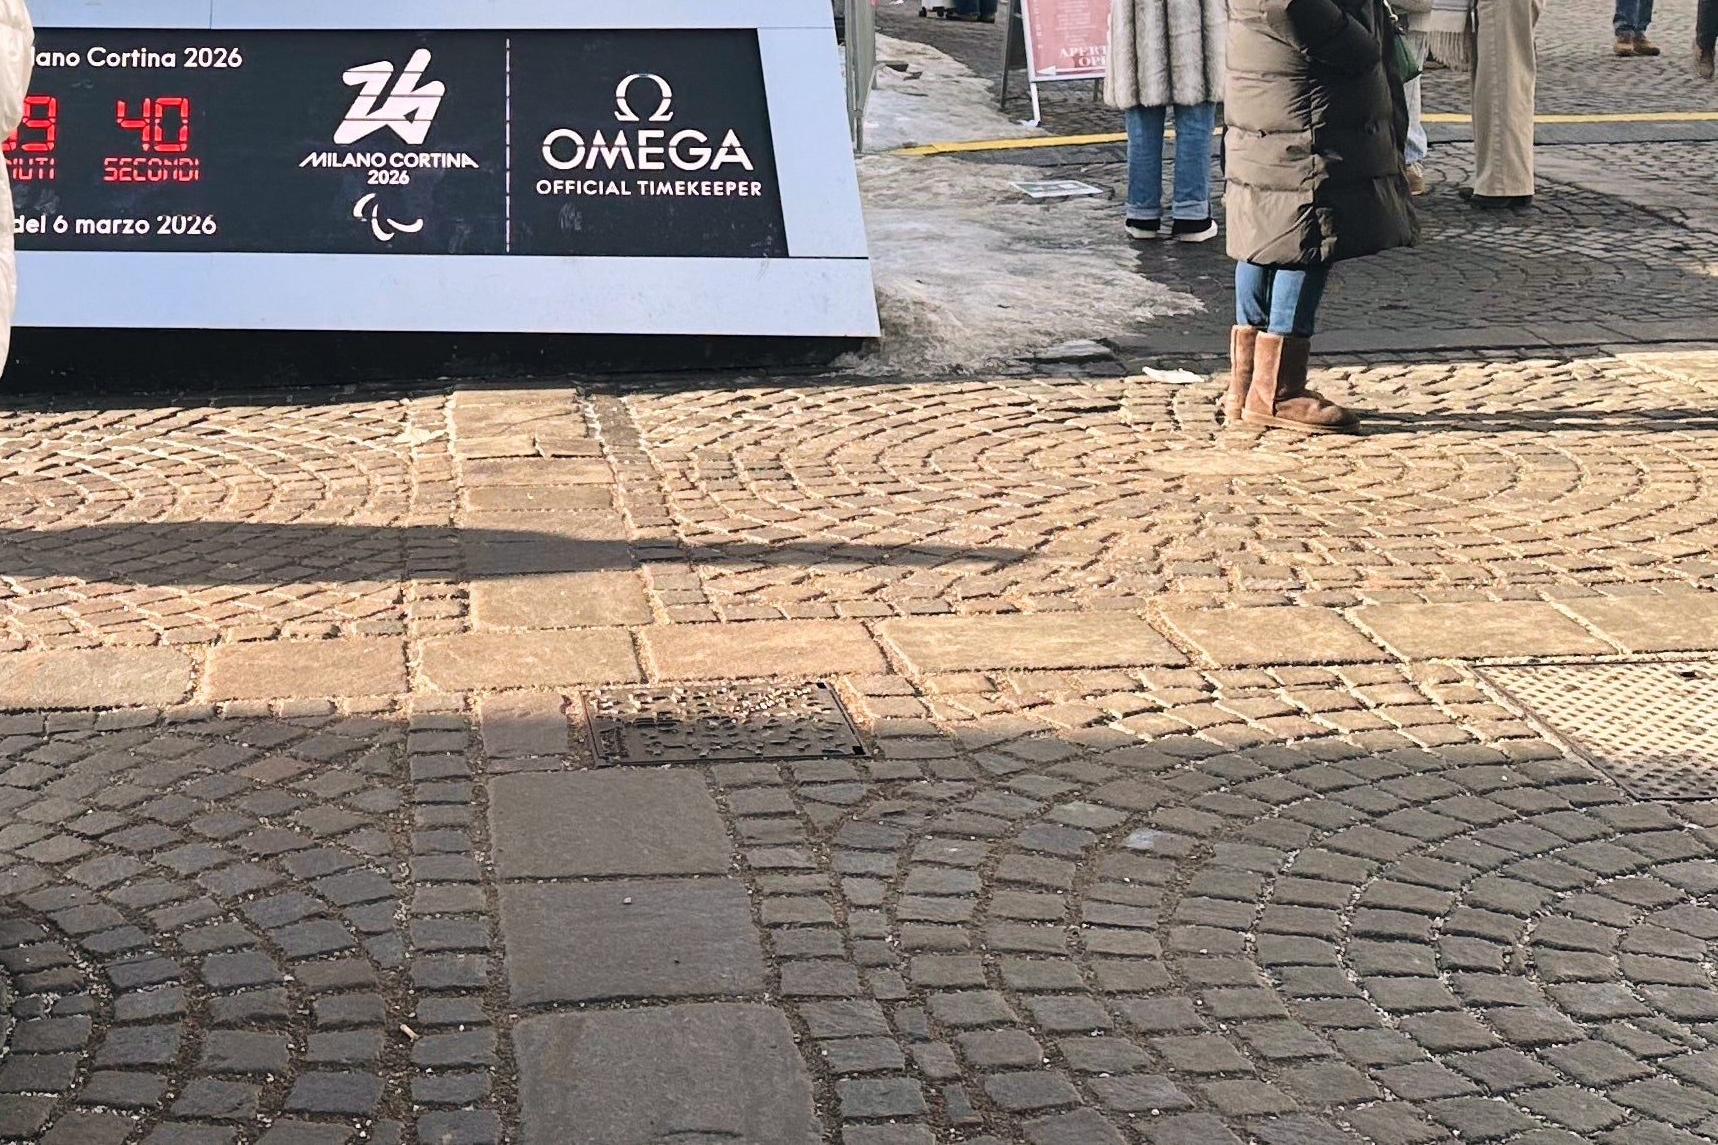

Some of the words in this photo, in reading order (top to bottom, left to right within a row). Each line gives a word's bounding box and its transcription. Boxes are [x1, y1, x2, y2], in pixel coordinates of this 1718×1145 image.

[30, 45, 81, 67] lano
[86, 46, 176, 68] Cortina
[183, 47, 243, 68] 2026
[1, 95, 57, 151] 9
[116, 97, 189, 152] 40
[298, 152, 387, 168] MILANO
[389, 152, 480, 169] CORTINA
[541, 128, 754, 171] OMEGA
[5, 157, 55, 180] NUTI
[103, 157, 199, 182] SECONDI
[367, 170, 411, 185] 2026
[535, 179, 632, 195] OFFICIAL
[637, 180, 762, 197] TIMEKEEPER
[13, 214, 46, 234] del
[52, 214, 69, 234] 6
[75, 218, 150, 234] marzo
[156, 214, 217, 235] 2026
